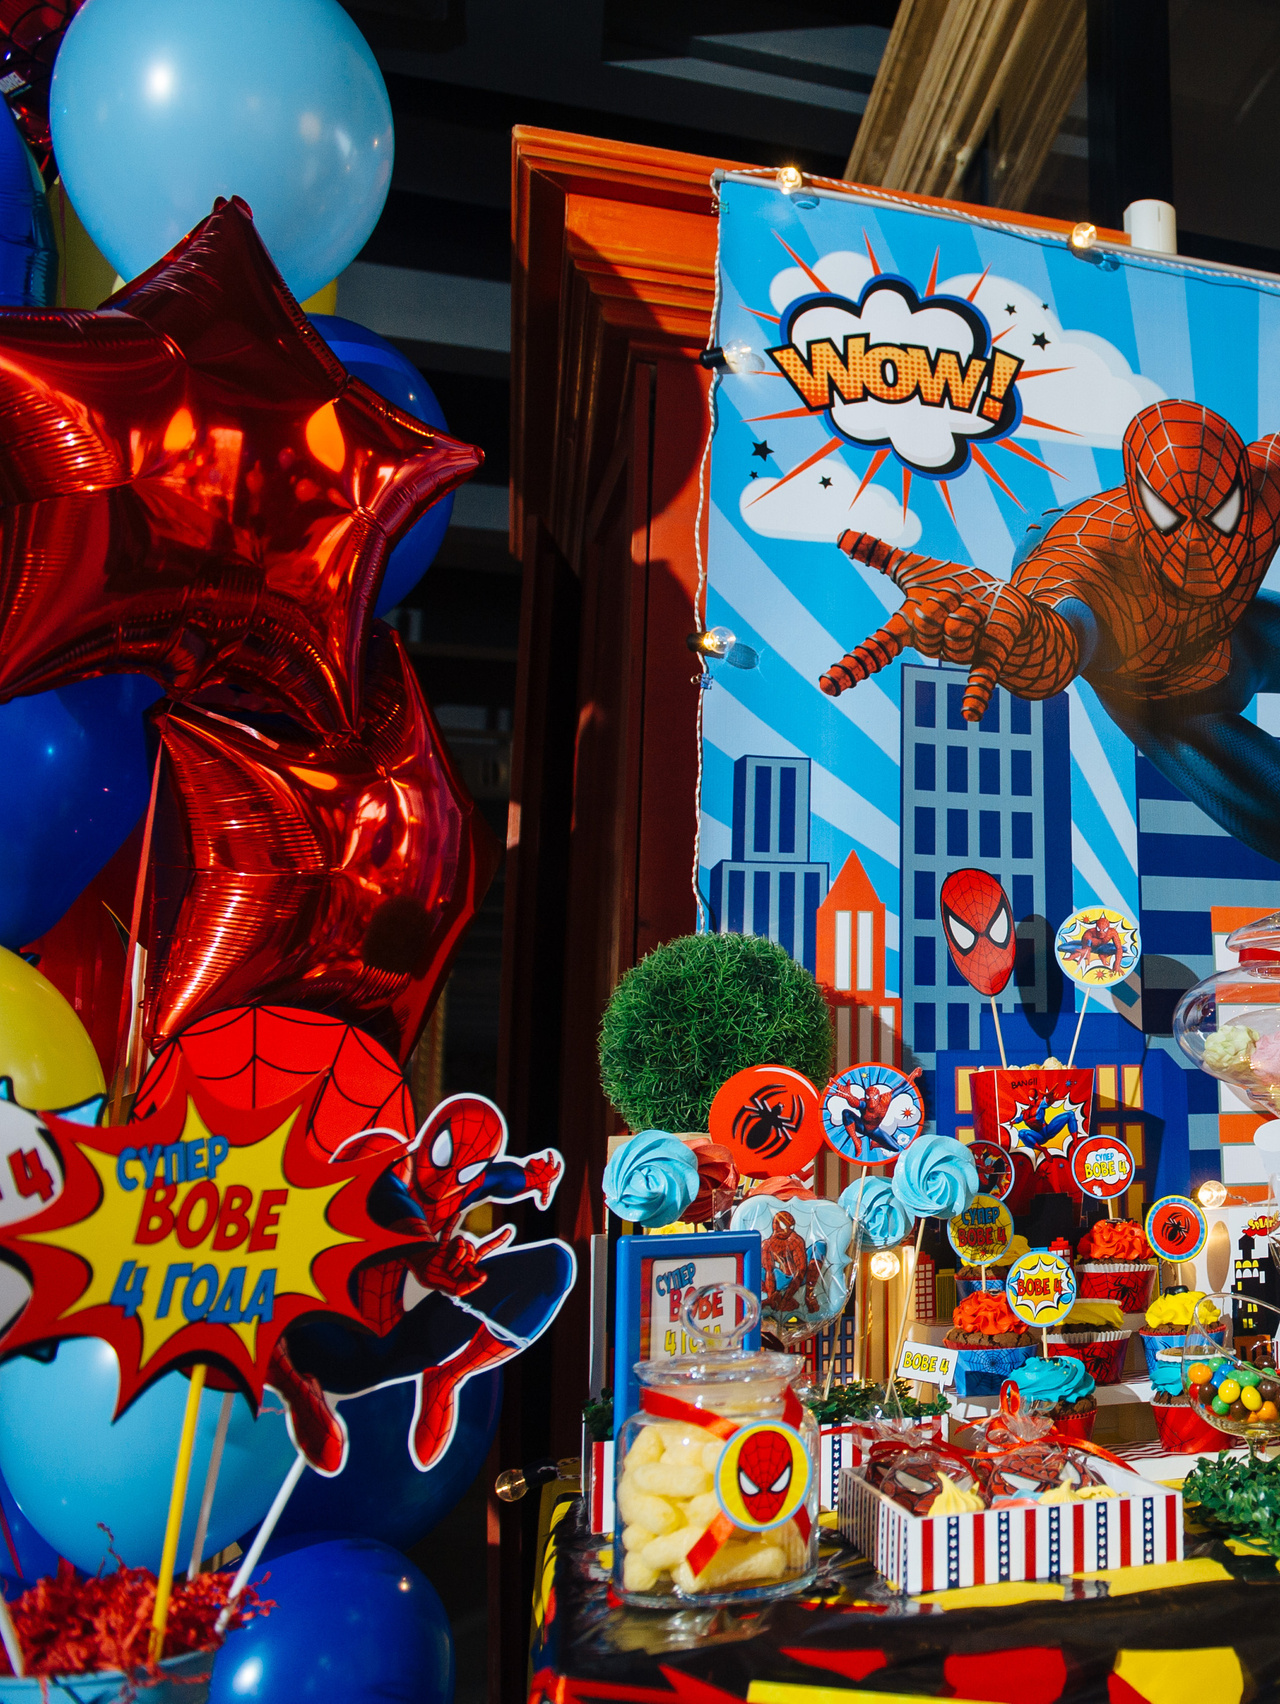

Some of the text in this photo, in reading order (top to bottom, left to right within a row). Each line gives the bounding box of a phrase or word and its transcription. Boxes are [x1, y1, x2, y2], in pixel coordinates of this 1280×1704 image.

[764, 331, 1025, 425] WOW!
[116, 1134, 230, 1191] СУПЕР
[1084, 1160, 1127, 1179] ВОВЕ 4
[1095, 1152, 1114, 1162] СУПЕР
[133, 1176, 289, 1254] ВОВЕ
[961, 1207, 999, 1225] СУПЕР
[958, 1227, 1007, 1247] ВОВЕ 4
[155, 1262, 278, 1324] ГОДА
[656, 1262, 696, 1297] СУПЕР
[1017, 1278, 1063, 1297] ВОВЕ 4
[664, 1329, 676, 1357] 4
[902, 1350, 950, 1376] ВОВЕ 4
